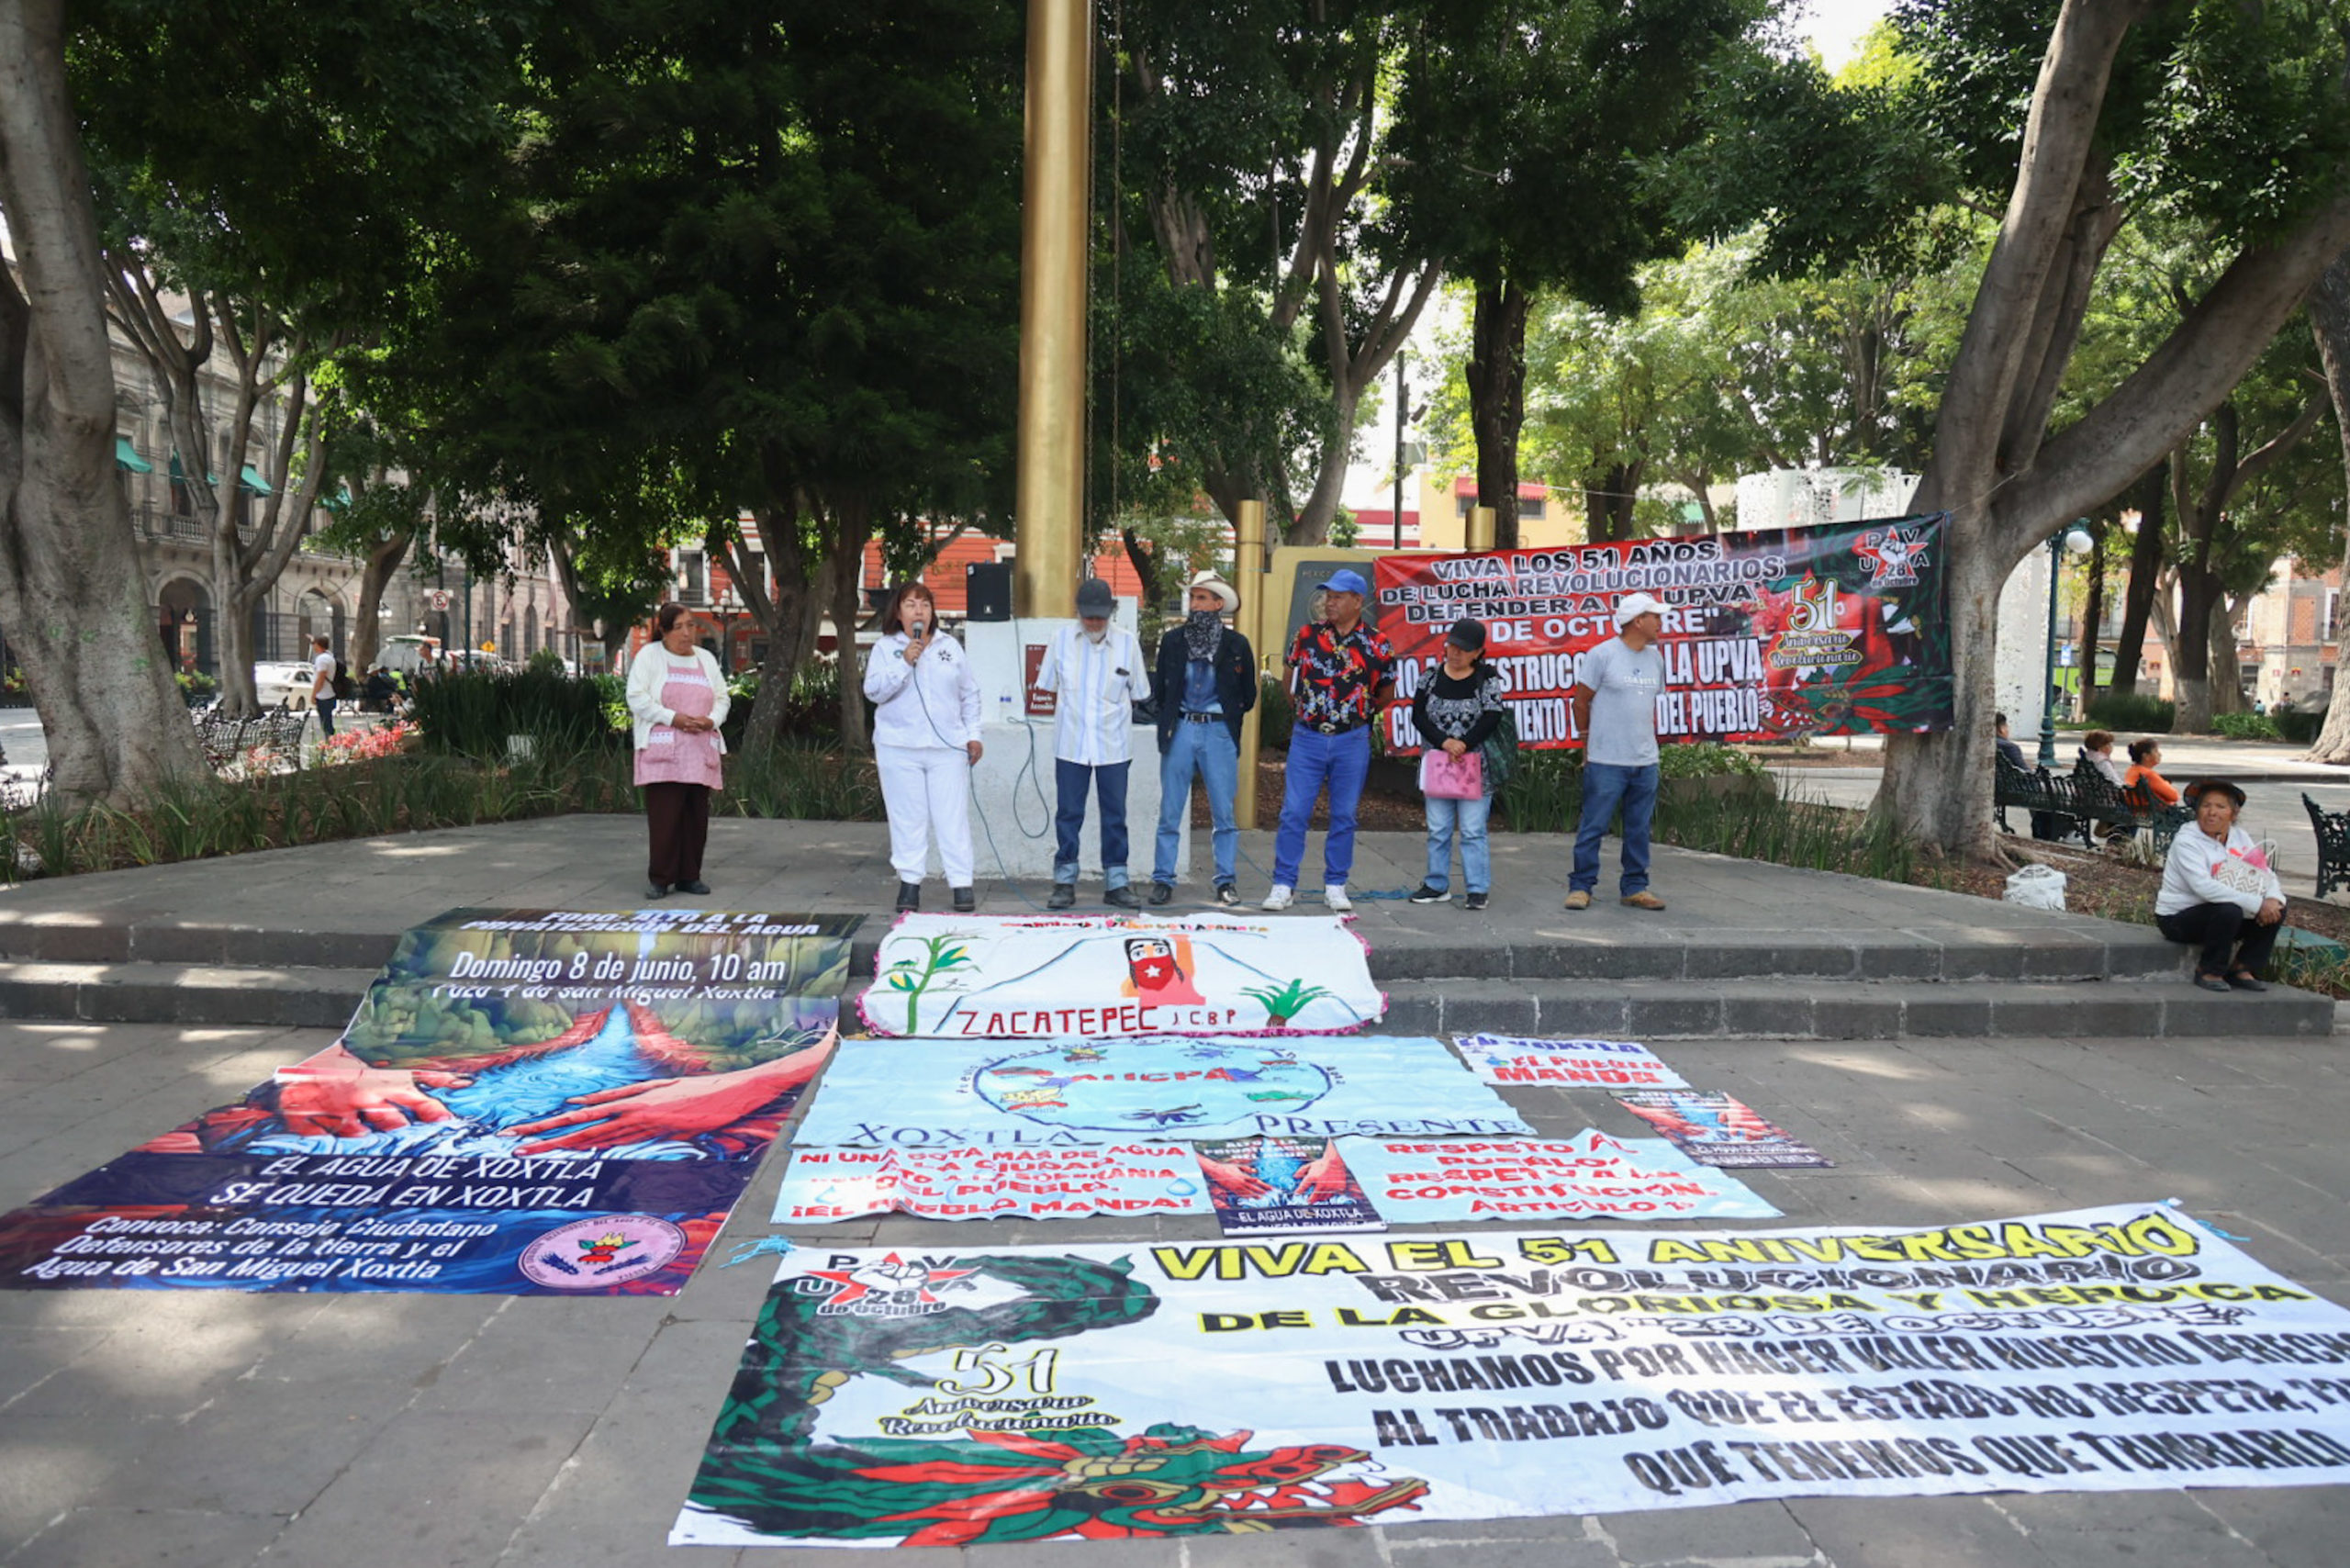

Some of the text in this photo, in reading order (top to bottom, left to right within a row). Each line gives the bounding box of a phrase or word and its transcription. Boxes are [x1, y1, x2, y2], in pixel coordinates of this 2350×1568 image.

[1902, 529, 1919, 543] V
[1432, 540, 1721, 580] VIVA LOS 51 AÑOS
[1860, 552, 1930, 571] U A
[1886, 563, 1908, 577] 28
[1381, 554, 1785, 605] DE LUCHA REVOLUCIONARIOS
[1405, 598, 1573, 624] DEFENDER
[1577, 595, 1609, 613] A
[1662, 584, 1757, 607] UPVA
[1789, 577, 1837, 632] 51
[1492, 620, 1534, 643] DE
[1781, 632, 1852, 648] Aniversario
[1664, 642, 1695, 684] LA
[1698, 638, 1763, 684] UPVA
[1771, 650, 1862, 667] Revolucionario
[1655, 687, 1760, 735] DEL PUEBLO
[449, 951, 787, 984] Domingo 8 de junio, 10 am
[956, 1005, 1158, 1036] ZACATEPEC
[1493, 1067, 1665, 1084] MANDA
[849, 1123, 1081, 1144] XOXTLA
[1254, 1113, 1528, 1136] PRESENTE
[800, 1154, 830, 1163] NI
[838, 1148, 899, 1162] UNA
[1061, 1150, 1099, 1159] DE
[1107, 1145, 1186, 1157] AGUA
[1383, 1140, 1575, 1153] RESPETO
[261, 1156, 606, 1181] EL AGUA DE XOXTLA
[209, 1181, 596, 1209] SE QUEDA EN XOXTLA
[1030, 1197, 1193, 1215] MANDA!
[84, 1216, 498, 1239] Convoca: Consejo Ciudadano
[1238, 1212, 1258, 1223] EL
[1258, 1210, 1293, 1222] AGUA
[1314, 1207, 1364, 1219] XOXTLA
[52, 1236, 470, 1260] Defensores de la tierra y el
[1152, 1212, 2200, 1281] VIVA EL 51 ANIVERSARIO
[21, 1256, 443, 1281] Agua de San Miguel Xoxtla
[827, 1254, 957, 1271] P V
[794, 1279, 837, 1296] U
[1354, 1254, 2203, 1304] REVOLUCIONARIO
[865, 1289, 919, 1305] 28
[1198, 1282, 2318, 1333] DE LA GLORIOSA Y HEROICA
[1398, 1320, 1626, 1350] UPVA
[1765, 1313, 1879, 1335] DE
[937, 1342, 1058, 1396] 51
[1325, 1351, 1595, 1393] LUCHAMOS
[1591, 1342, 1698, 1380] POR
[1690, 1338, 1859, 1376] HACER
[1839, 1336, 2000, 1372] VALER
[1979, 1333, 2202, 1371] NUESTRO
[879, 1411, 1122, 1436] Revolucionario
[1372, 1408, 1438, 1448] AL
[1434, 1397, 1669, 1443] TRABAJO
[1666, 1388, 1778, 1427] QUE
[1764, 1390, 1840, 1424] EL
[1821, 1380, 2020, 1423] ESTADO
[2002, 1383, 2096, 1419] NO
[1623, 1440, 1745, 1495] QUE
[1726, 1436, 1989, 1483] TENEMOS
[1972, 1432, 2101, 1478] QUE
